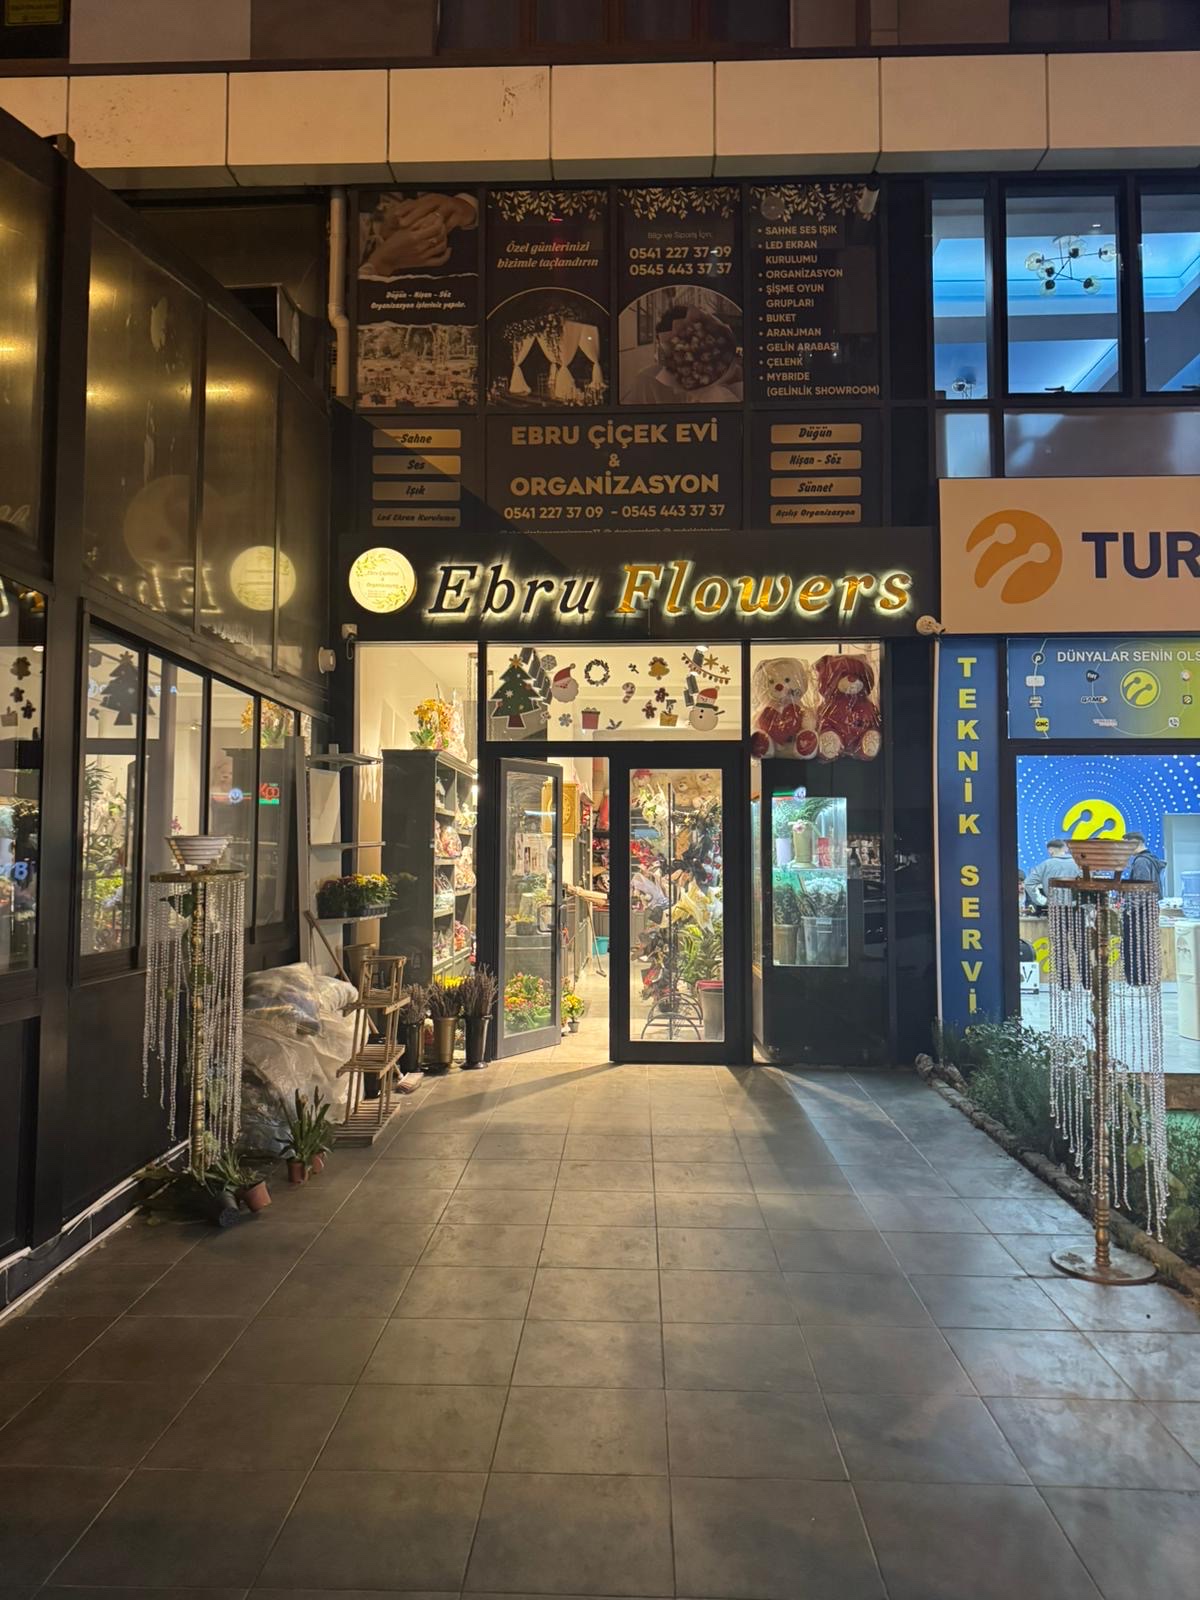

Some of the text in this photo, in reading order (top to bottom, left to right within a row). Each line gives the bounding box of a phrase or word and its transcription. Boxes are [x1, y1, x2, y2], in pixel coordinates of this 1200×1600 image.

[765, 225, 838, 236] SAHNE SES IŞIK
[506, 240, 590, 255] Özel günlerinizi
[765, 240, 818, 250] LED EKRAN
[629, 246, 732, 259] 0541 227 37 09
[497, 257, 599, 270] bizimle taçlandırın
[766, 255, 818, 264] KURULUMU
[629, 262, 732, 276] 0545 443 37 37
[766, 268, 843, 279] ORGANİZASYON
[766, 283, 824, 296] ŞİŞME OYUN
[766, 298, 815, 308] GRUPLARI
[766, 313, 796, 322] BUKET
[766, 328, 822, 337] ARANJMAN
[766, 341, 840, 352] GELİN ARABASI
[766, 357, 803, 368] ÇELENK
[767, 372, 810, 381] MYBRIDE
[767, 384, 880, 397] (GELİNLİK SHOWROOM)
[400, 433, 432, 444] Sahne
[511, 417, 718, 449] EBRU ÇİÇEK EVİ
[798, 425, 833, 441] Düğün
[407, 459, 425, 470] Ses
[608, 453, 620, 467] &
[789, 454, 815, 468] Nişan
[824, 452, 842, 465] Söz
[510, 470, 719, 496] ORGANİZASYON
[797, 480, 834, 493] Sünnet
[406, 485, 426, 498] Işık
[503, 507, 536, 519] 0541
[539, 507, 563, 519] 227
[566, 506, 582, 518] 37
[585, 506, 604, 518] 09
[622, 505, 657, 518] 0545
[660, 504, 686, 517] 443
[690, 504, 706, 516] 37
[709, 504, 725, 516] 37
[800, 509, 855, 518] Organizasyon
[1081, 532, 1200, 578] TUR
[427, 559, 913, 615] Ebru Flowers
[1057, 649, 1130, 662] DÜNYALAR
[1132, 648, 1173, 662] SENİN
[957, 657, 983, 1034] TEKNİK SERVİ
